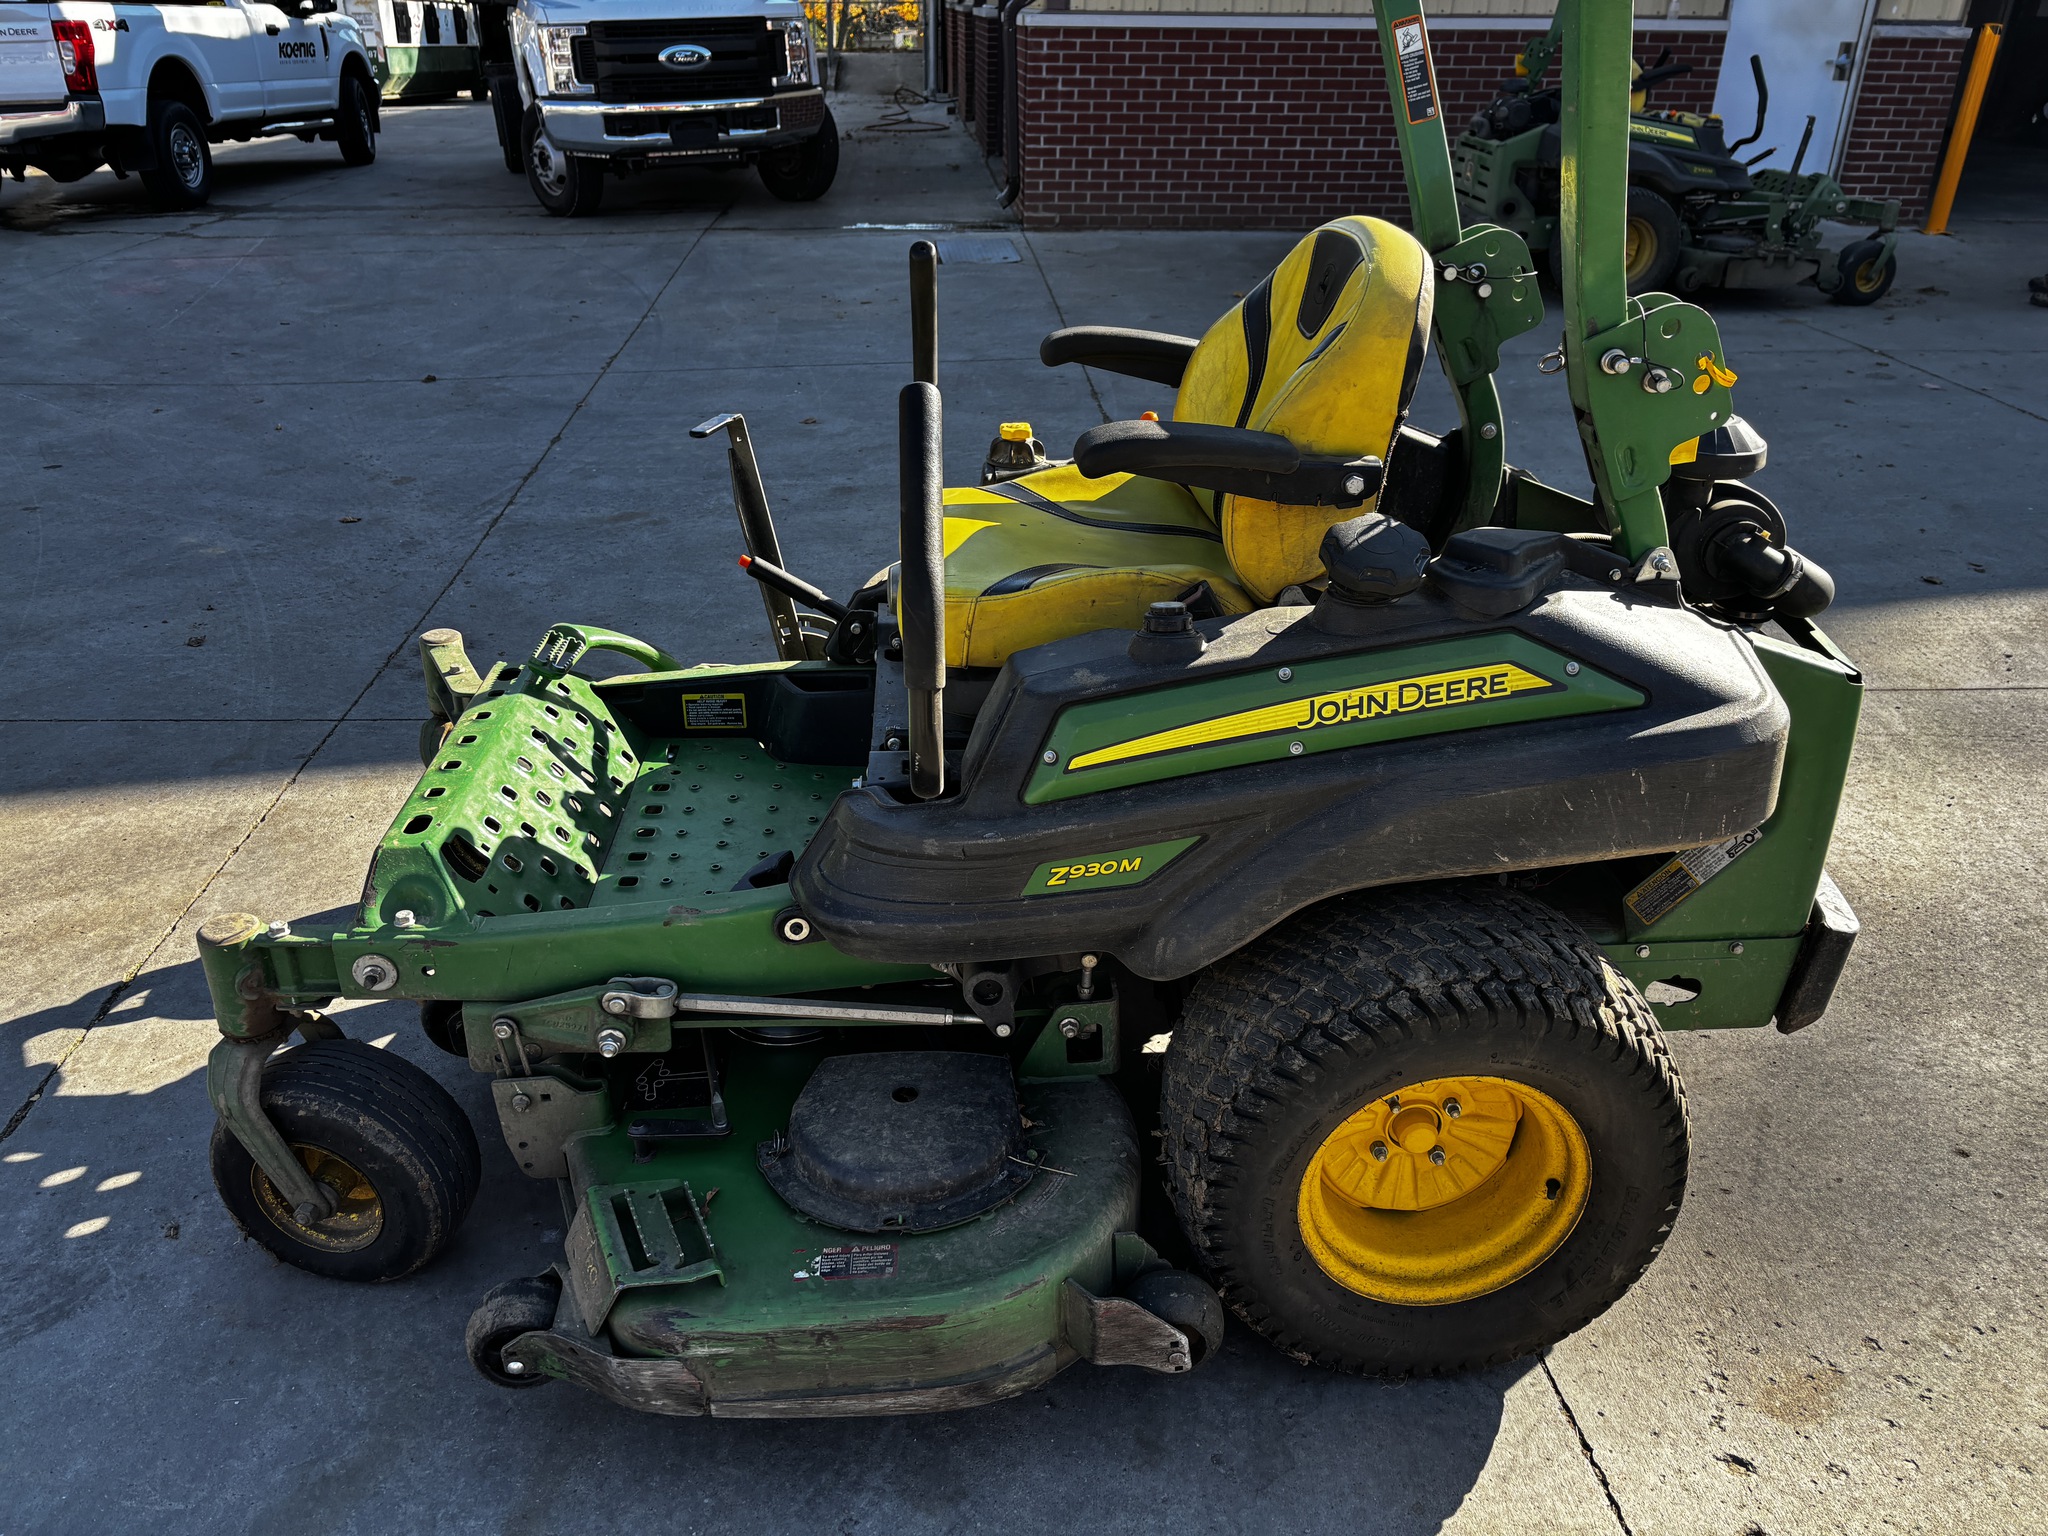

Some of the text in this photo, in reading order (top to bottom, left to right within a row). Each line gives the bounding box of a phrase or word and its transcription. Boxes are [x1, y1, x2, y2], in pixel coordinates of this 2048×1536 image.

[673, 51, 699, 63] Ford
[1297, 671, 1510, 730] JOHN DEERE
[1045, 856, 1142, 887] Z930M
